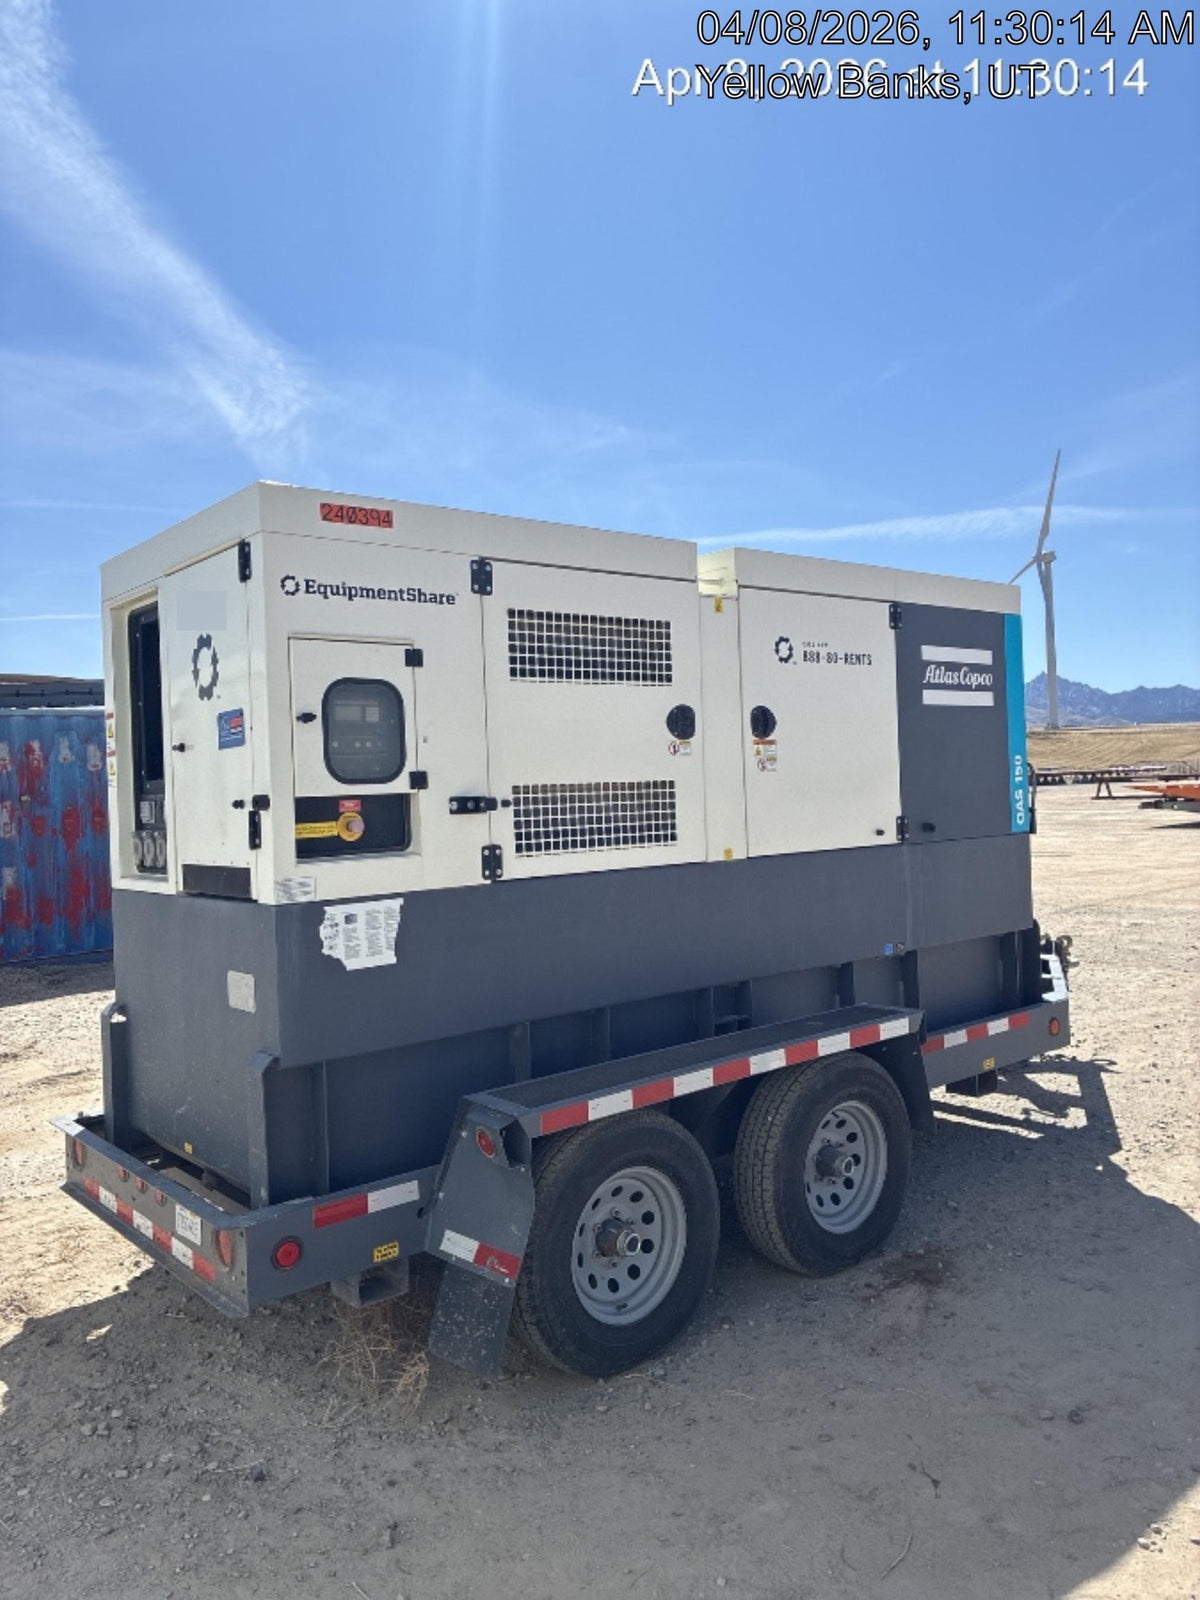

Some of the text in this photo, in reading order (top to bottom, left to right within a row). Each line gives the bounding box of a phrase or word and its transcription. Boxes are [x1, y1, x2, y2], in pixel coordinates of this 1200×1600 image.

[320, 503, 394, 528] 240394
[304, 578, 456, 605] EquipmentShare
[1014, 755, 1023, 785] 150
